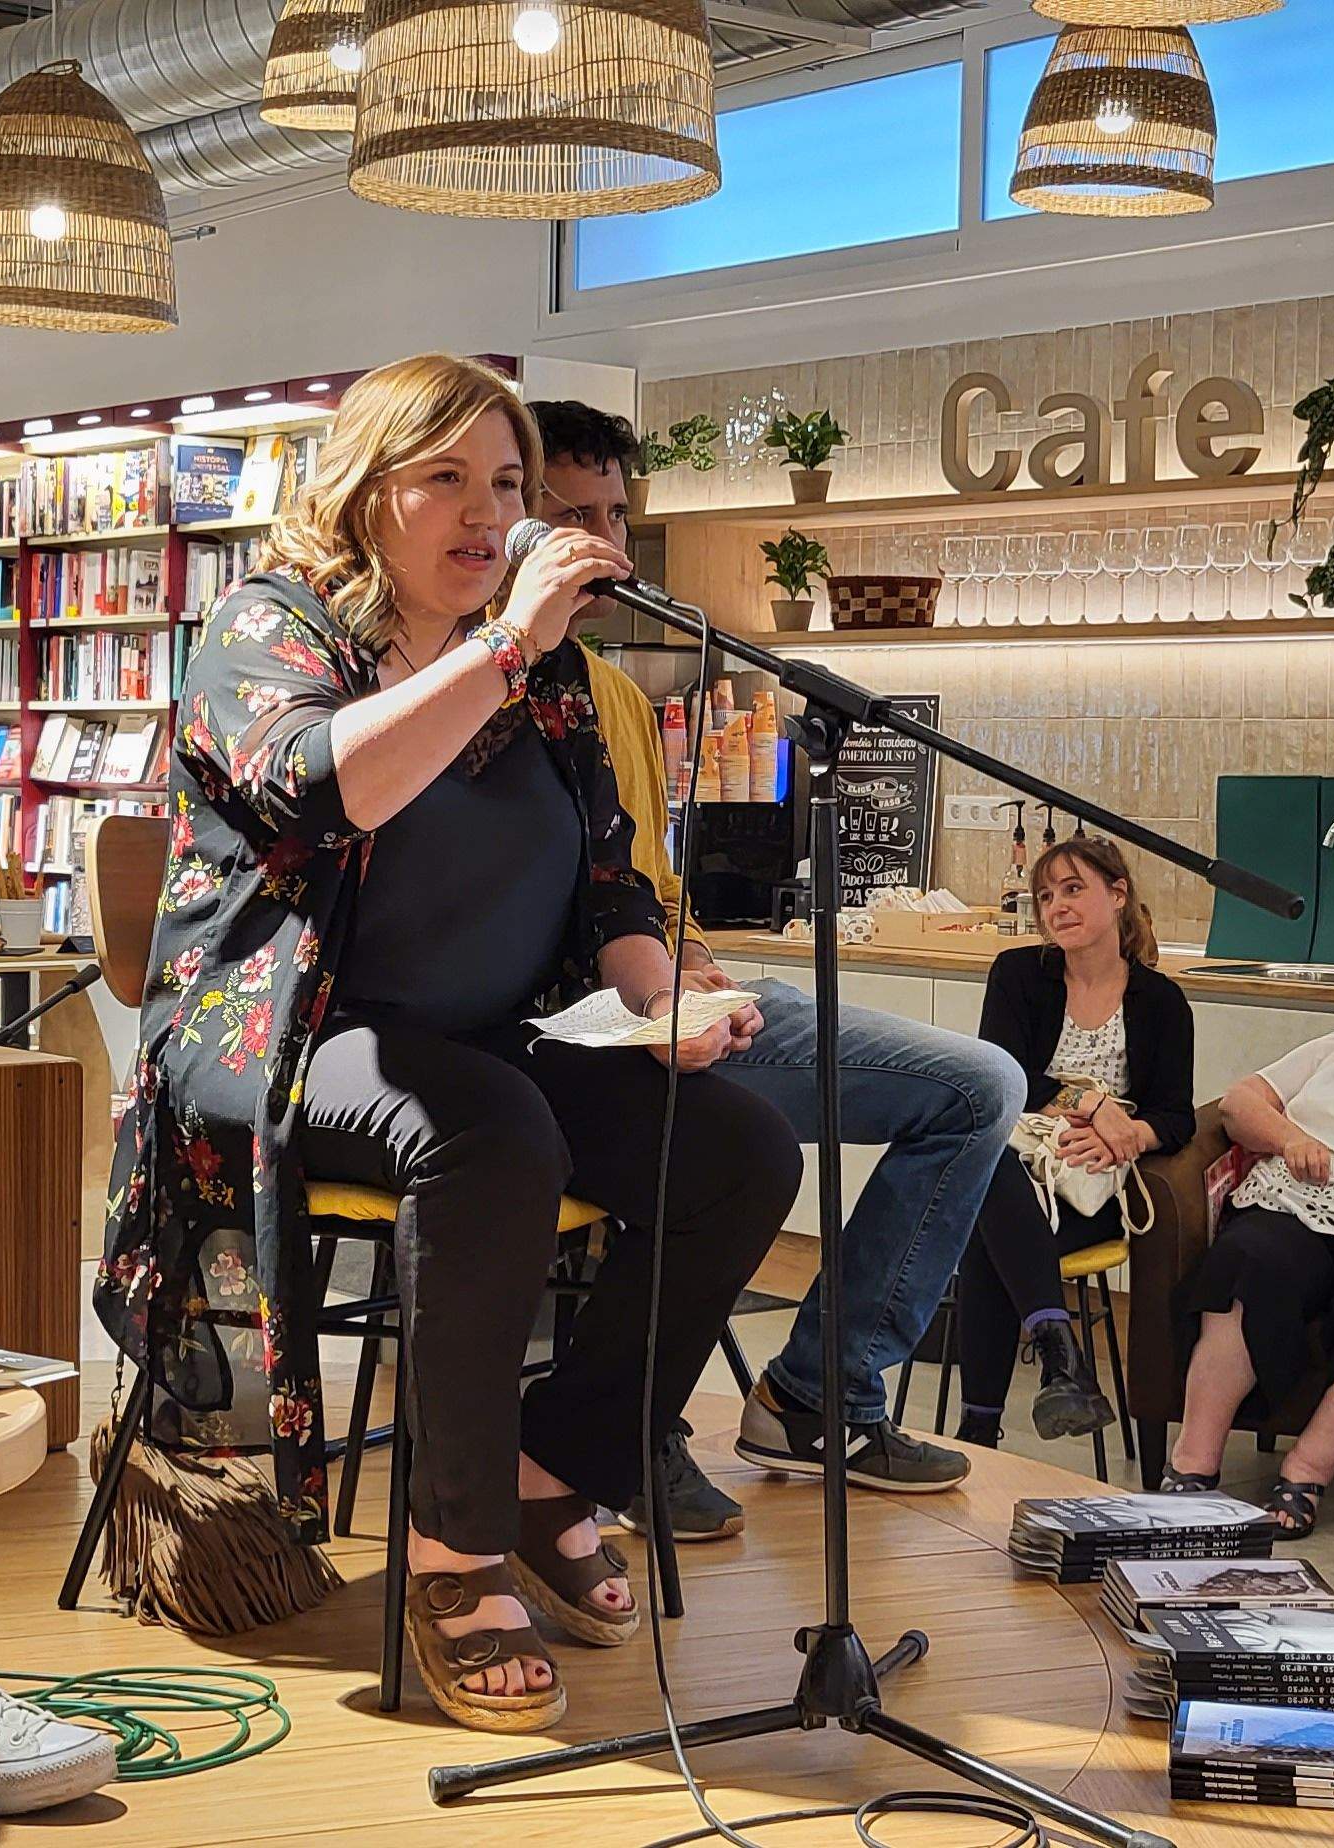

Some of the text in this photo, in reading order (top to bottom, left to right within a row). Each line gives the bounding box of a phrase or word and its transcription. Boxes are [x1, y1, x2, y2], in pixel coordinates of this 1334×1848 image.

[942, 353, 1265, 493] Cafe
[878, 735, 917, 748] ECOLÓGICO
[838, 750, 916, 762] OMERCIO JUSTO
[839, 872, 865, 887] TADO
[873, 866, 908, 885] HUESCA
[1221, 1524, 1249, 1532] JUAN
